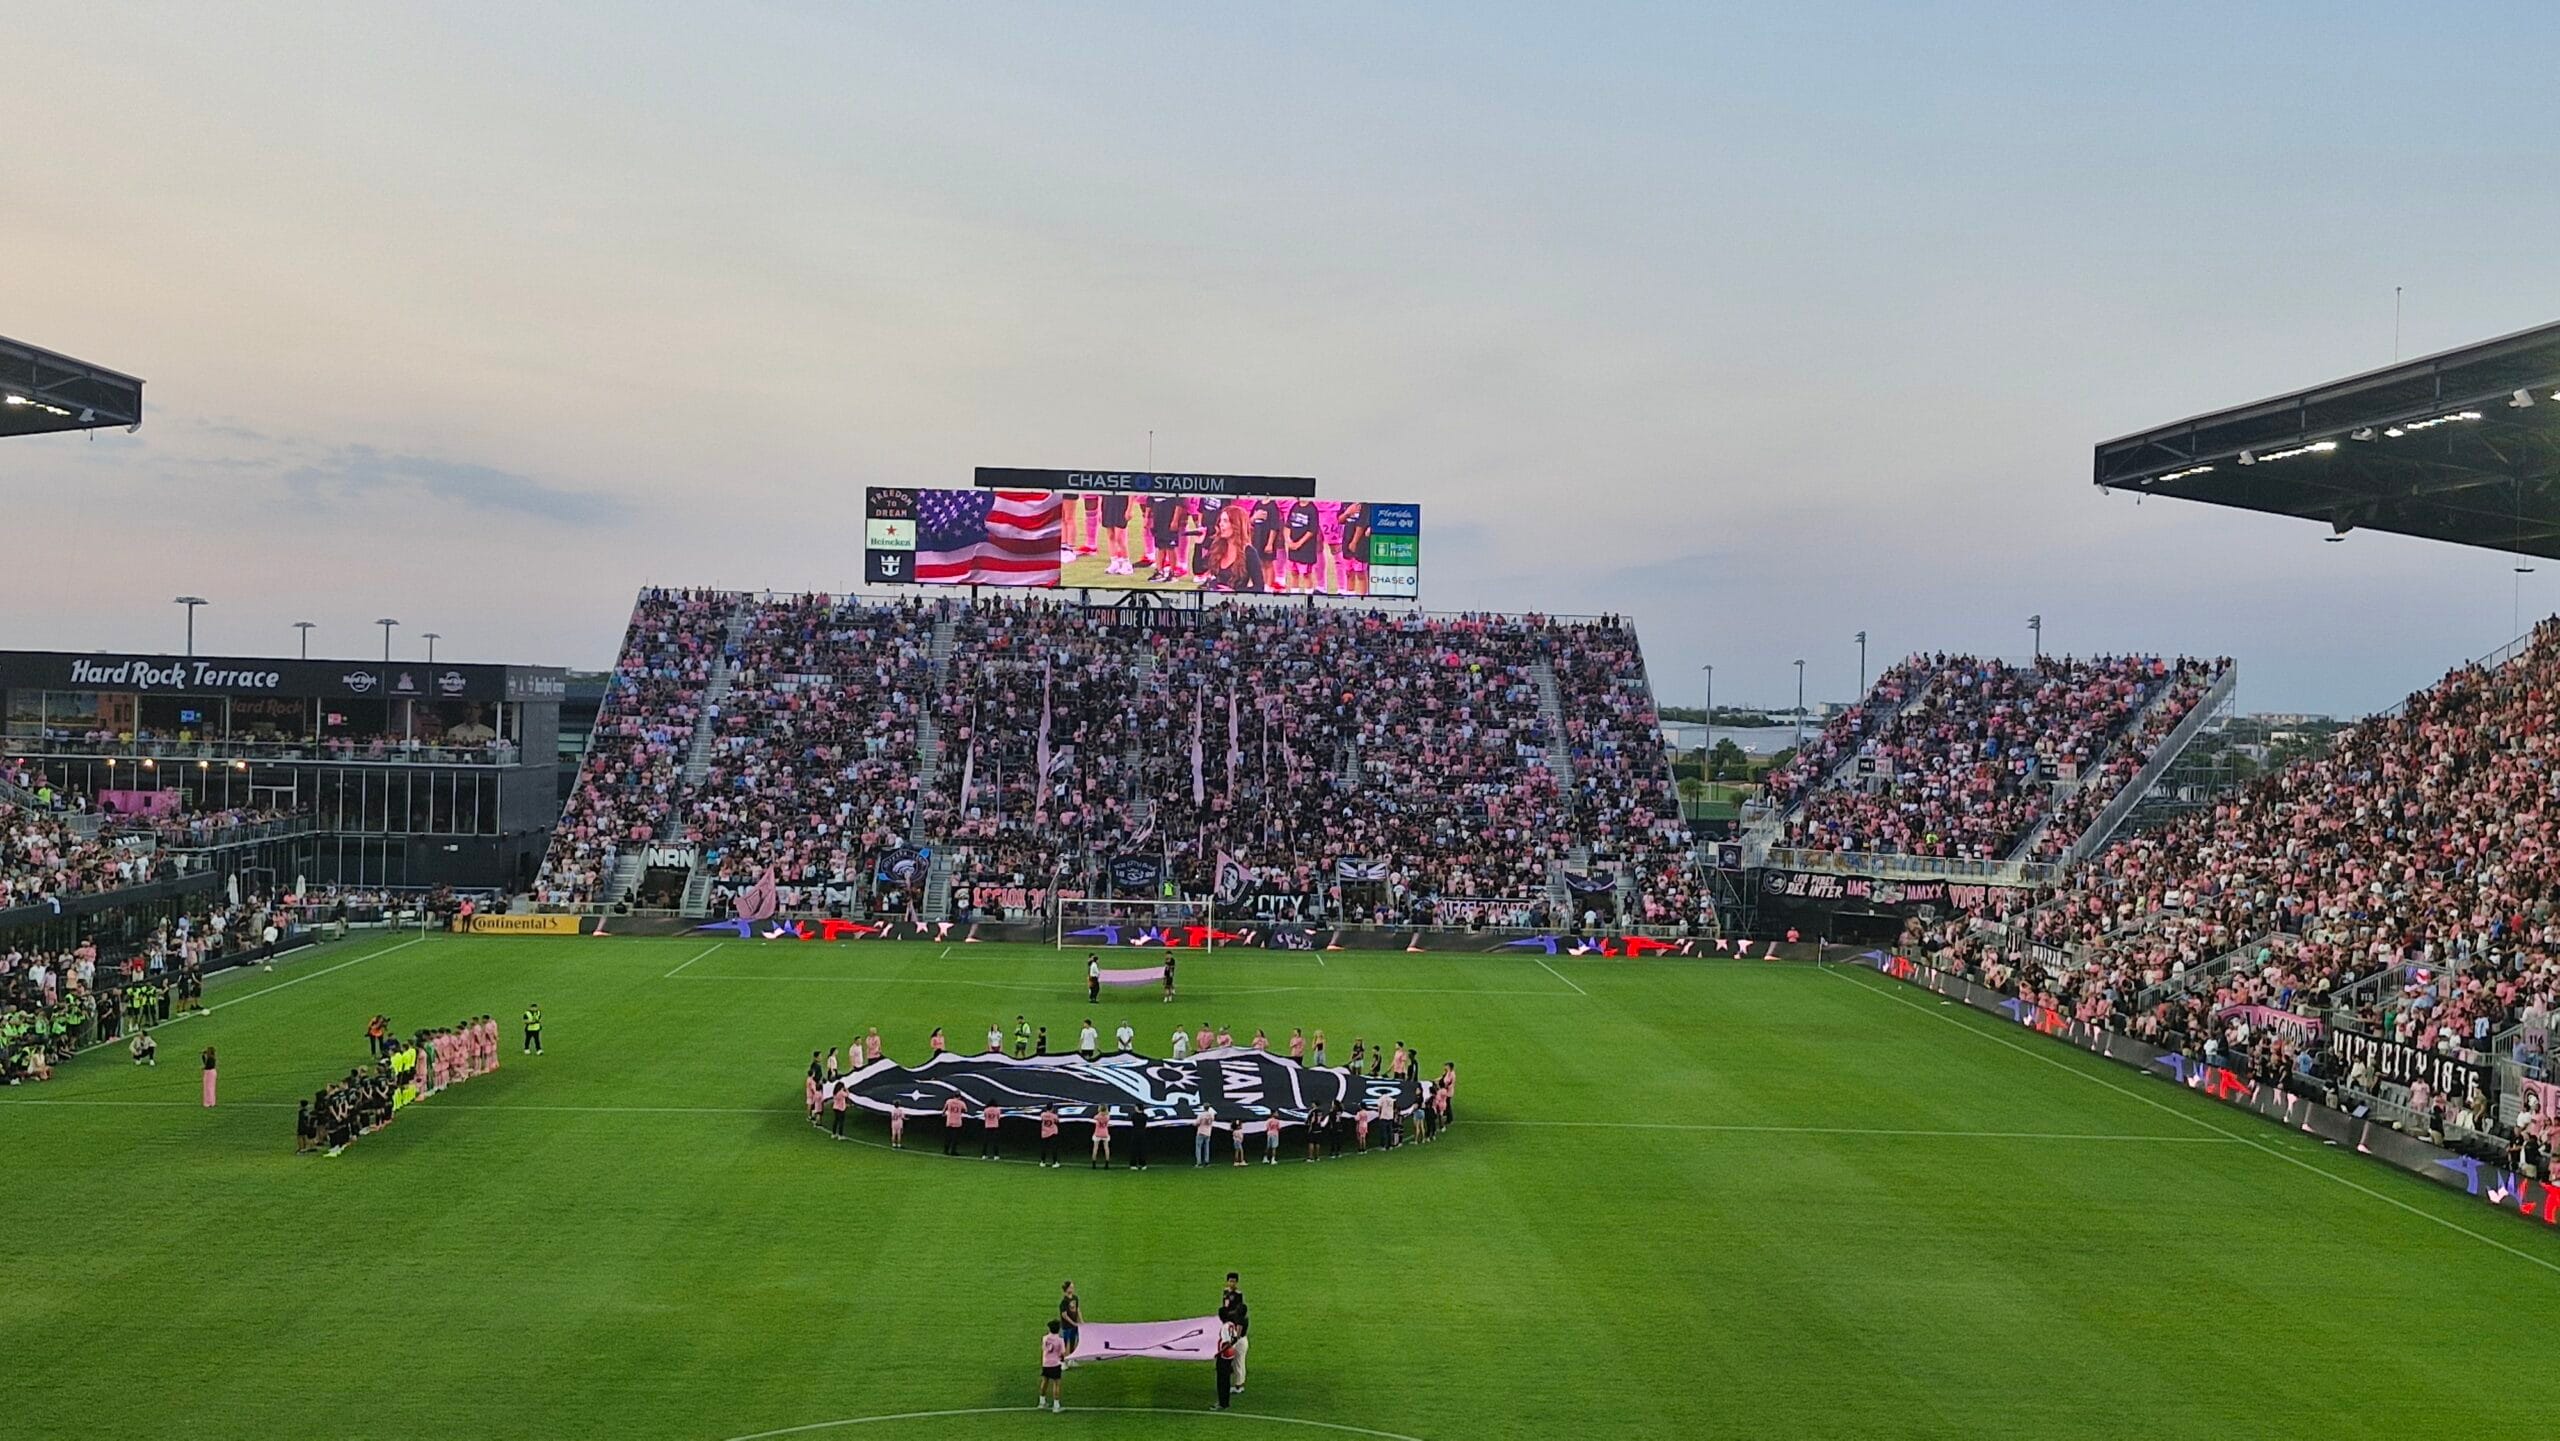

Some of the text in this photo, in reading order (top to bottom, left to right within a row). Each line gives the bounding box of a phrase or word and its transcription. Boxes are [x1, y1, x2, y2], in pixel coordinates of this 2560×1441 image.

[1068, 473, 1224, 491] CHASE STADIUM
[870, 489, 913, 506] FREEDOM
[875, 509, 907, 517] DREAM
[871, 538, 911, 546] Heineken
[1370, 575, 1405, 585] CHASE
[71, 659, 280, 689] Hard Rock Terrace
[1808, 885, 1843, 898] INTER
[1906, 883, 1945, 901] MMXX
[472, 916, 547, 931] Continental
[2381, 1042, 2427, 1081] CITY
